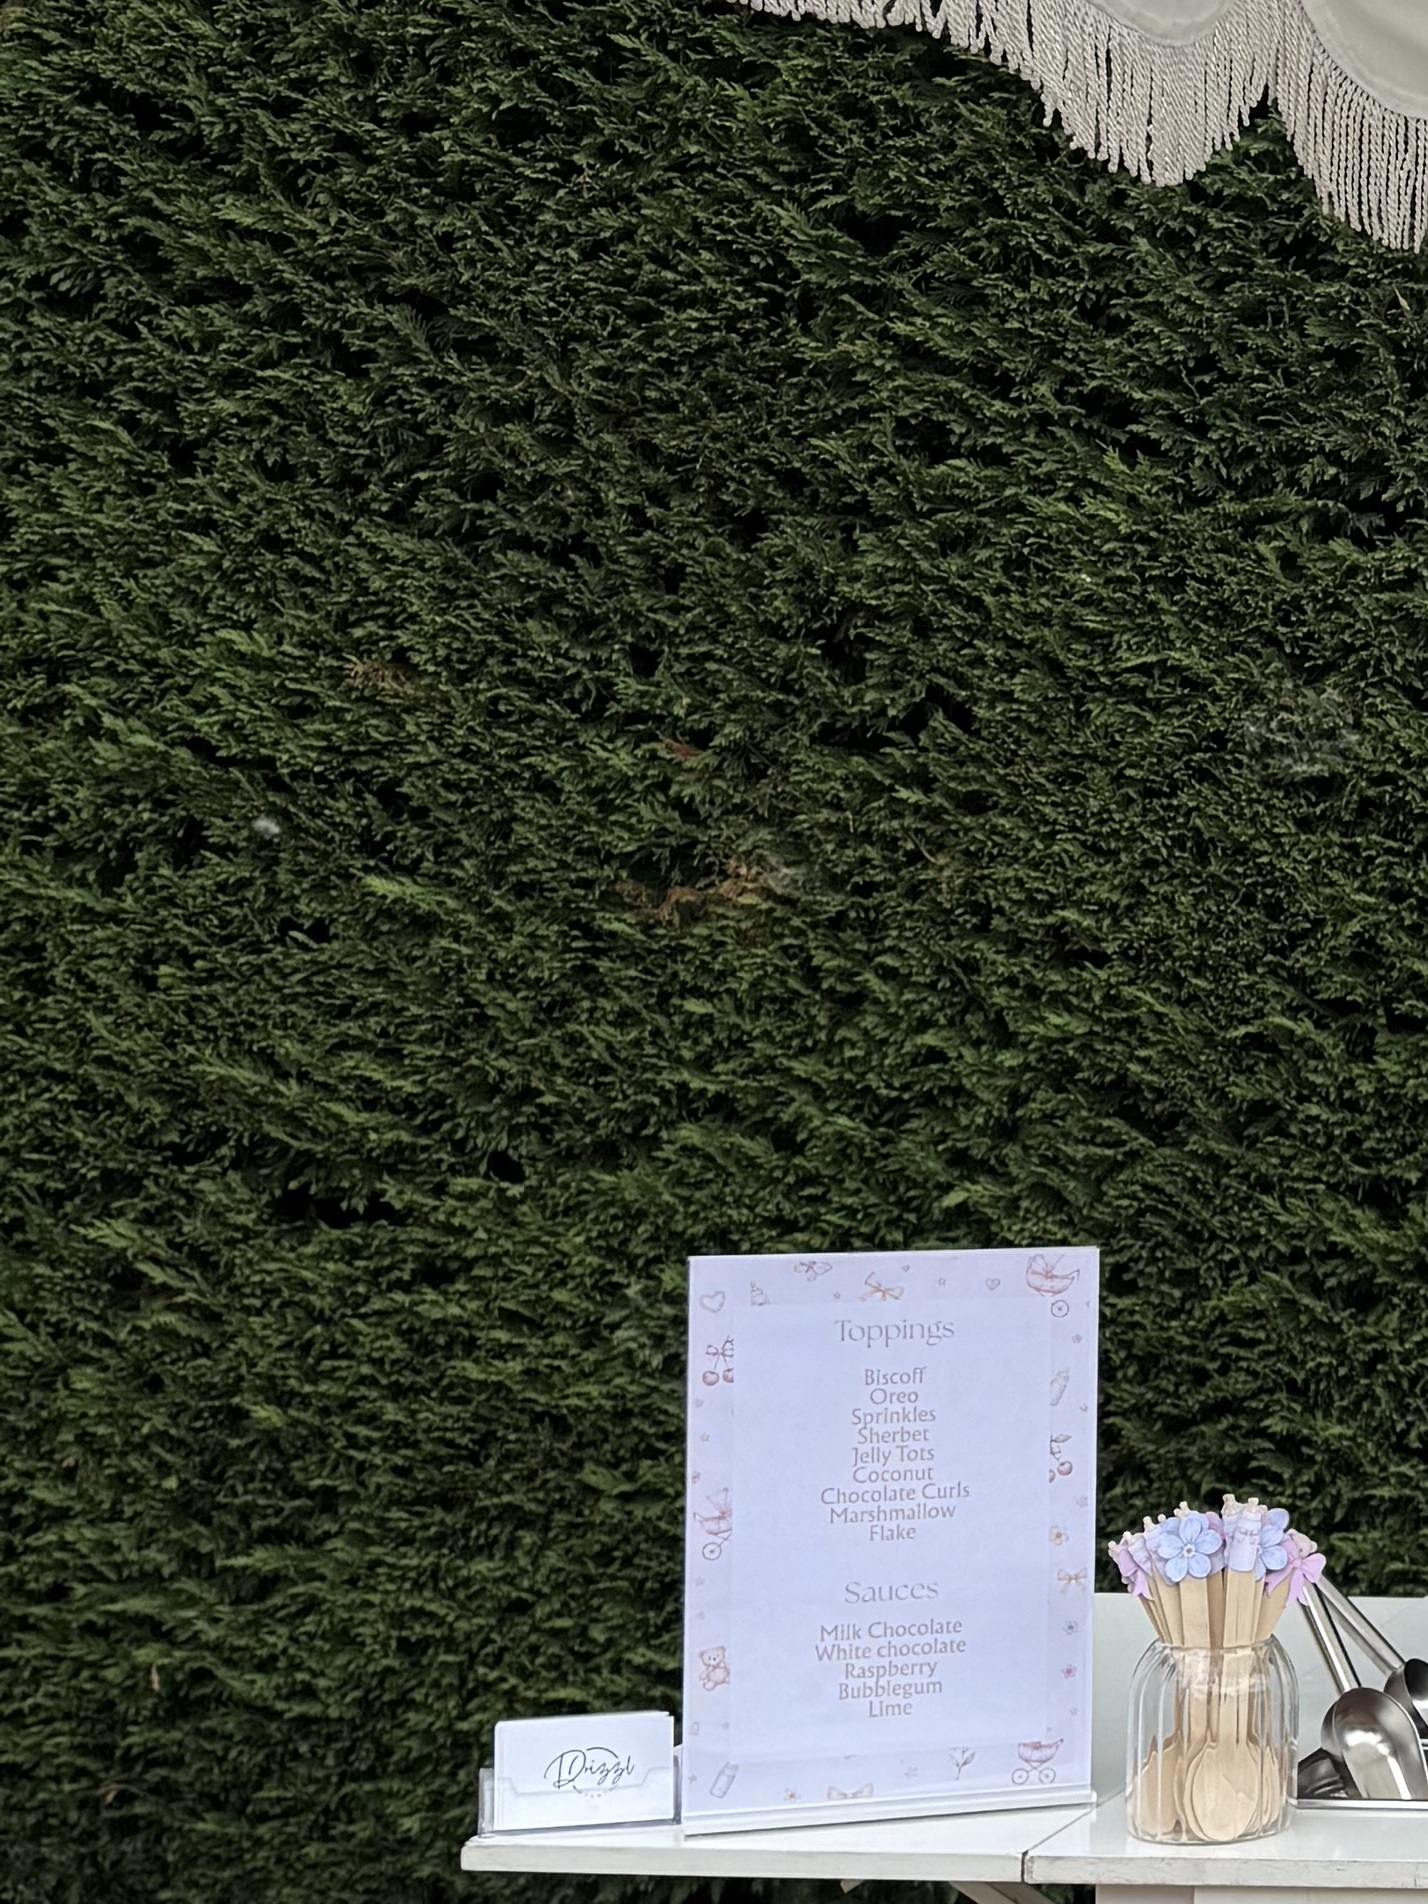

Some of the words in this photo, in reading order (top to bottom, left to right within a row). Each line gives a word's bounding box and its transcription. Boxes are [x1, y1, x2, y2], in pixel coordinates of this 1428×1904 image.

[833, 1319, 955, 1348] Toppings
[864, 1366, 927, 1385] Biscoff
[869, 1388, 919, 1404] Oreo
[851, 1406, 937, 1429] Sprinkles
[857, 1426, 929, 1444] Sherbet
[852, 1446, 892, 1467] Jelly
[896, 1445, 935, 1462] Tots
[853, 1466, 934, 1484] Coconut
[820, 1485, 916, 1505] Chocolate
[922, 1481, 971, 1500] Curls
[830, 1503, 957, 1524] Marshmallow
[870, 1524, 917, 1541] Flake
[844, 1581, 939, 1604] Sauces
[820, 1622, 862, 1642] Milk
[868, 1618, 963, 1639] Chocolate
[815, 1643, 872, 1661] White
[876, 1638, 967, 1658] chocolate
[844, 1660, 938, 1683] Raspberry
[838, 1680, 943, 1700] Bubblegum
[868, 1700, 913, 1718] Lime
